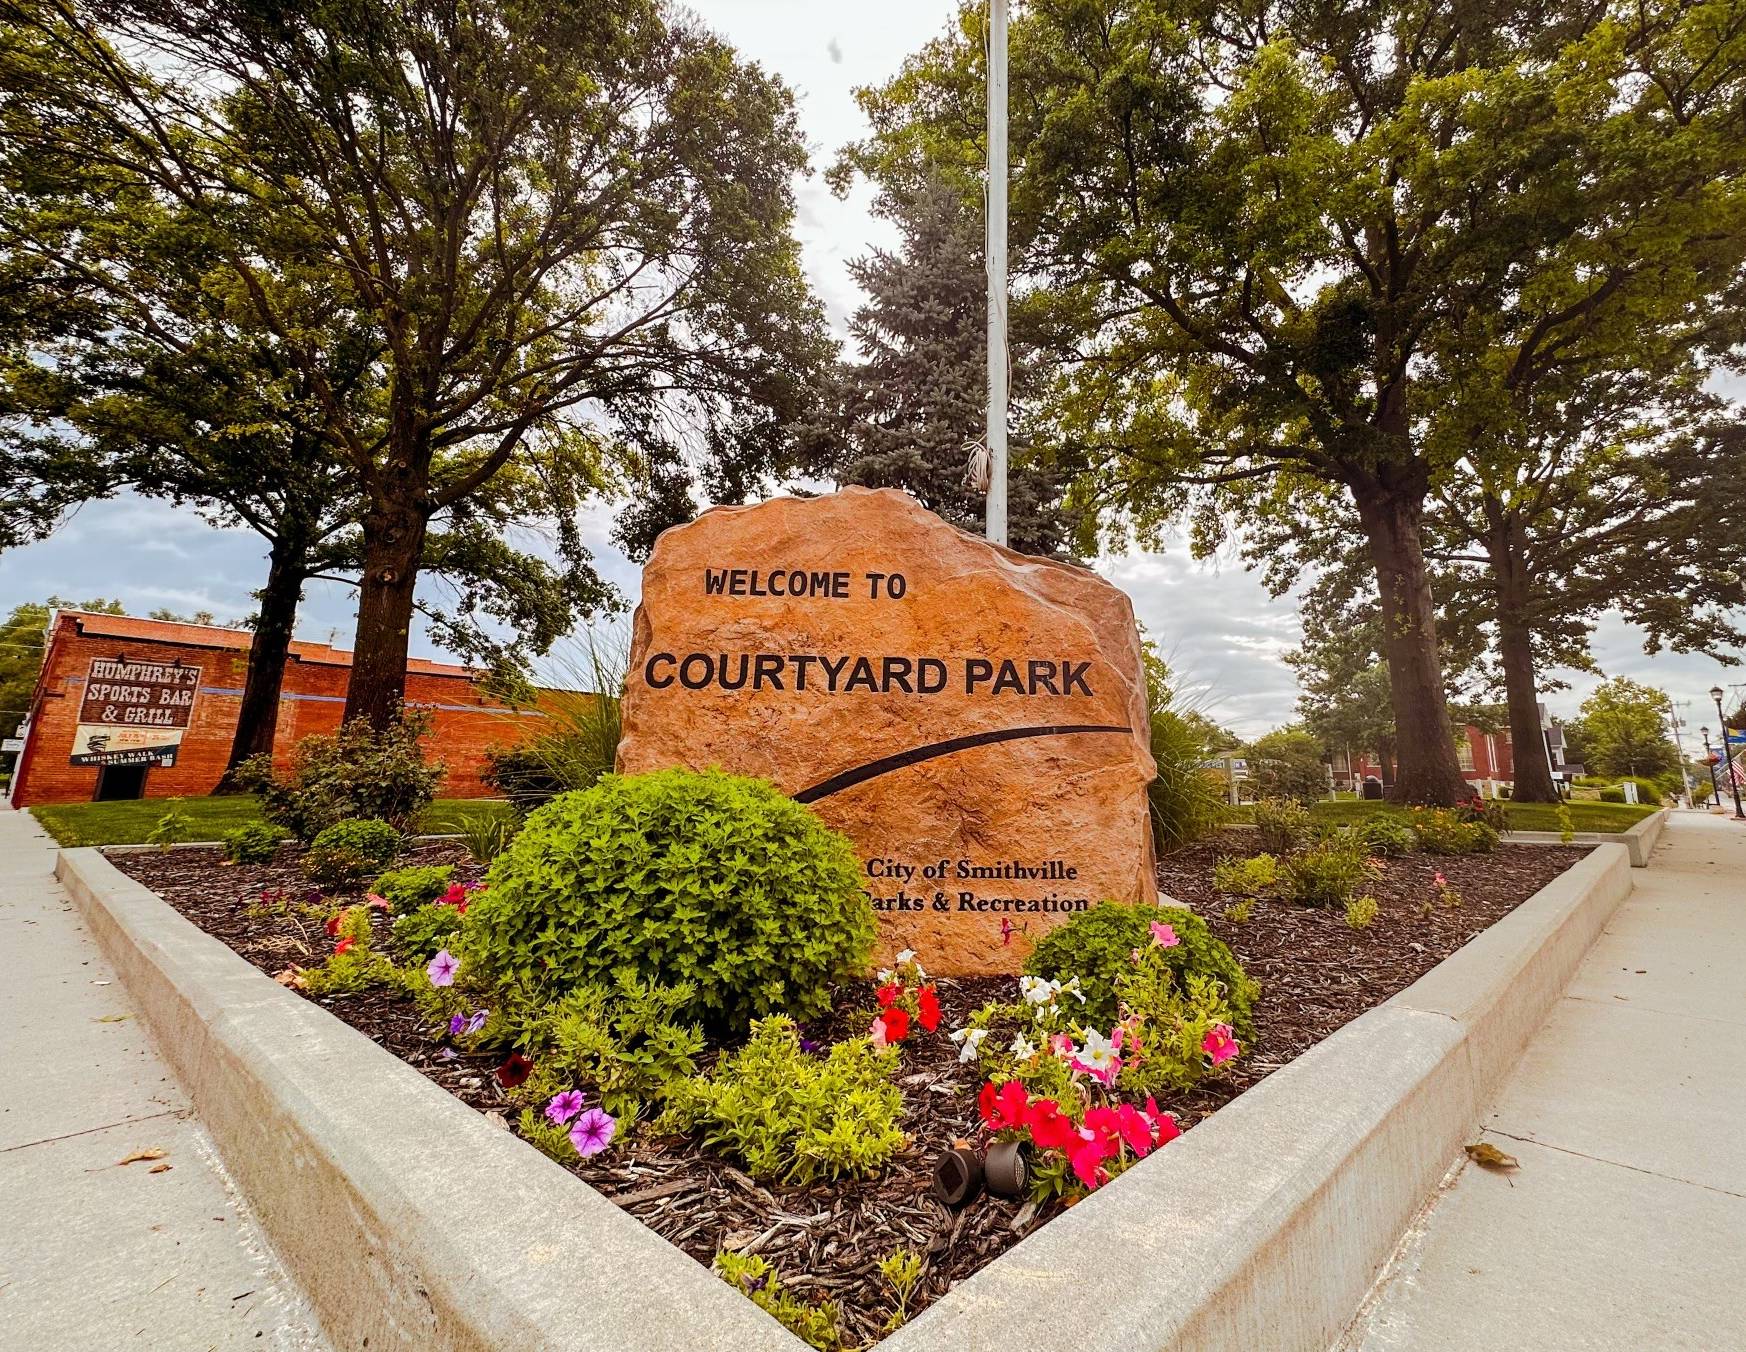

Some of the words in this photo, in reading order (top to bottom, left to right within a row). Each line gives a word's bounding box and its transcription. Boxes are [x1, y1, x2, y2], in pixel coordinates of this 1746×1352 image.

[705, 568, 850, 599] WELCOME
[866, 572, 907, 600] TO
[91, 661, 198, 685] HUMPHREY'S
[644, 652, 948, 695] COURTYARD
[965, 658, 1095, 697] PARK
[87, 683, 151, 703] SPORTS
[159, 688, 192, 706] BAR
[102, 704, 119, 722] &
[124, 707, 174, 725] GRILL
[81, 753, 125, 763] WHISKEY
[127, 750, 154, 758] WALK
[107, 756, 147, 765] SUMMER
[149, 753, 173, 761] BASH
[866, 858, 915, 884] City
[922, 859, 950, 879] of
[956, 858, 1078, 881] Smithville
[931, 891, 950, 912] &
[957, 891, 1088, 913] Recreation
